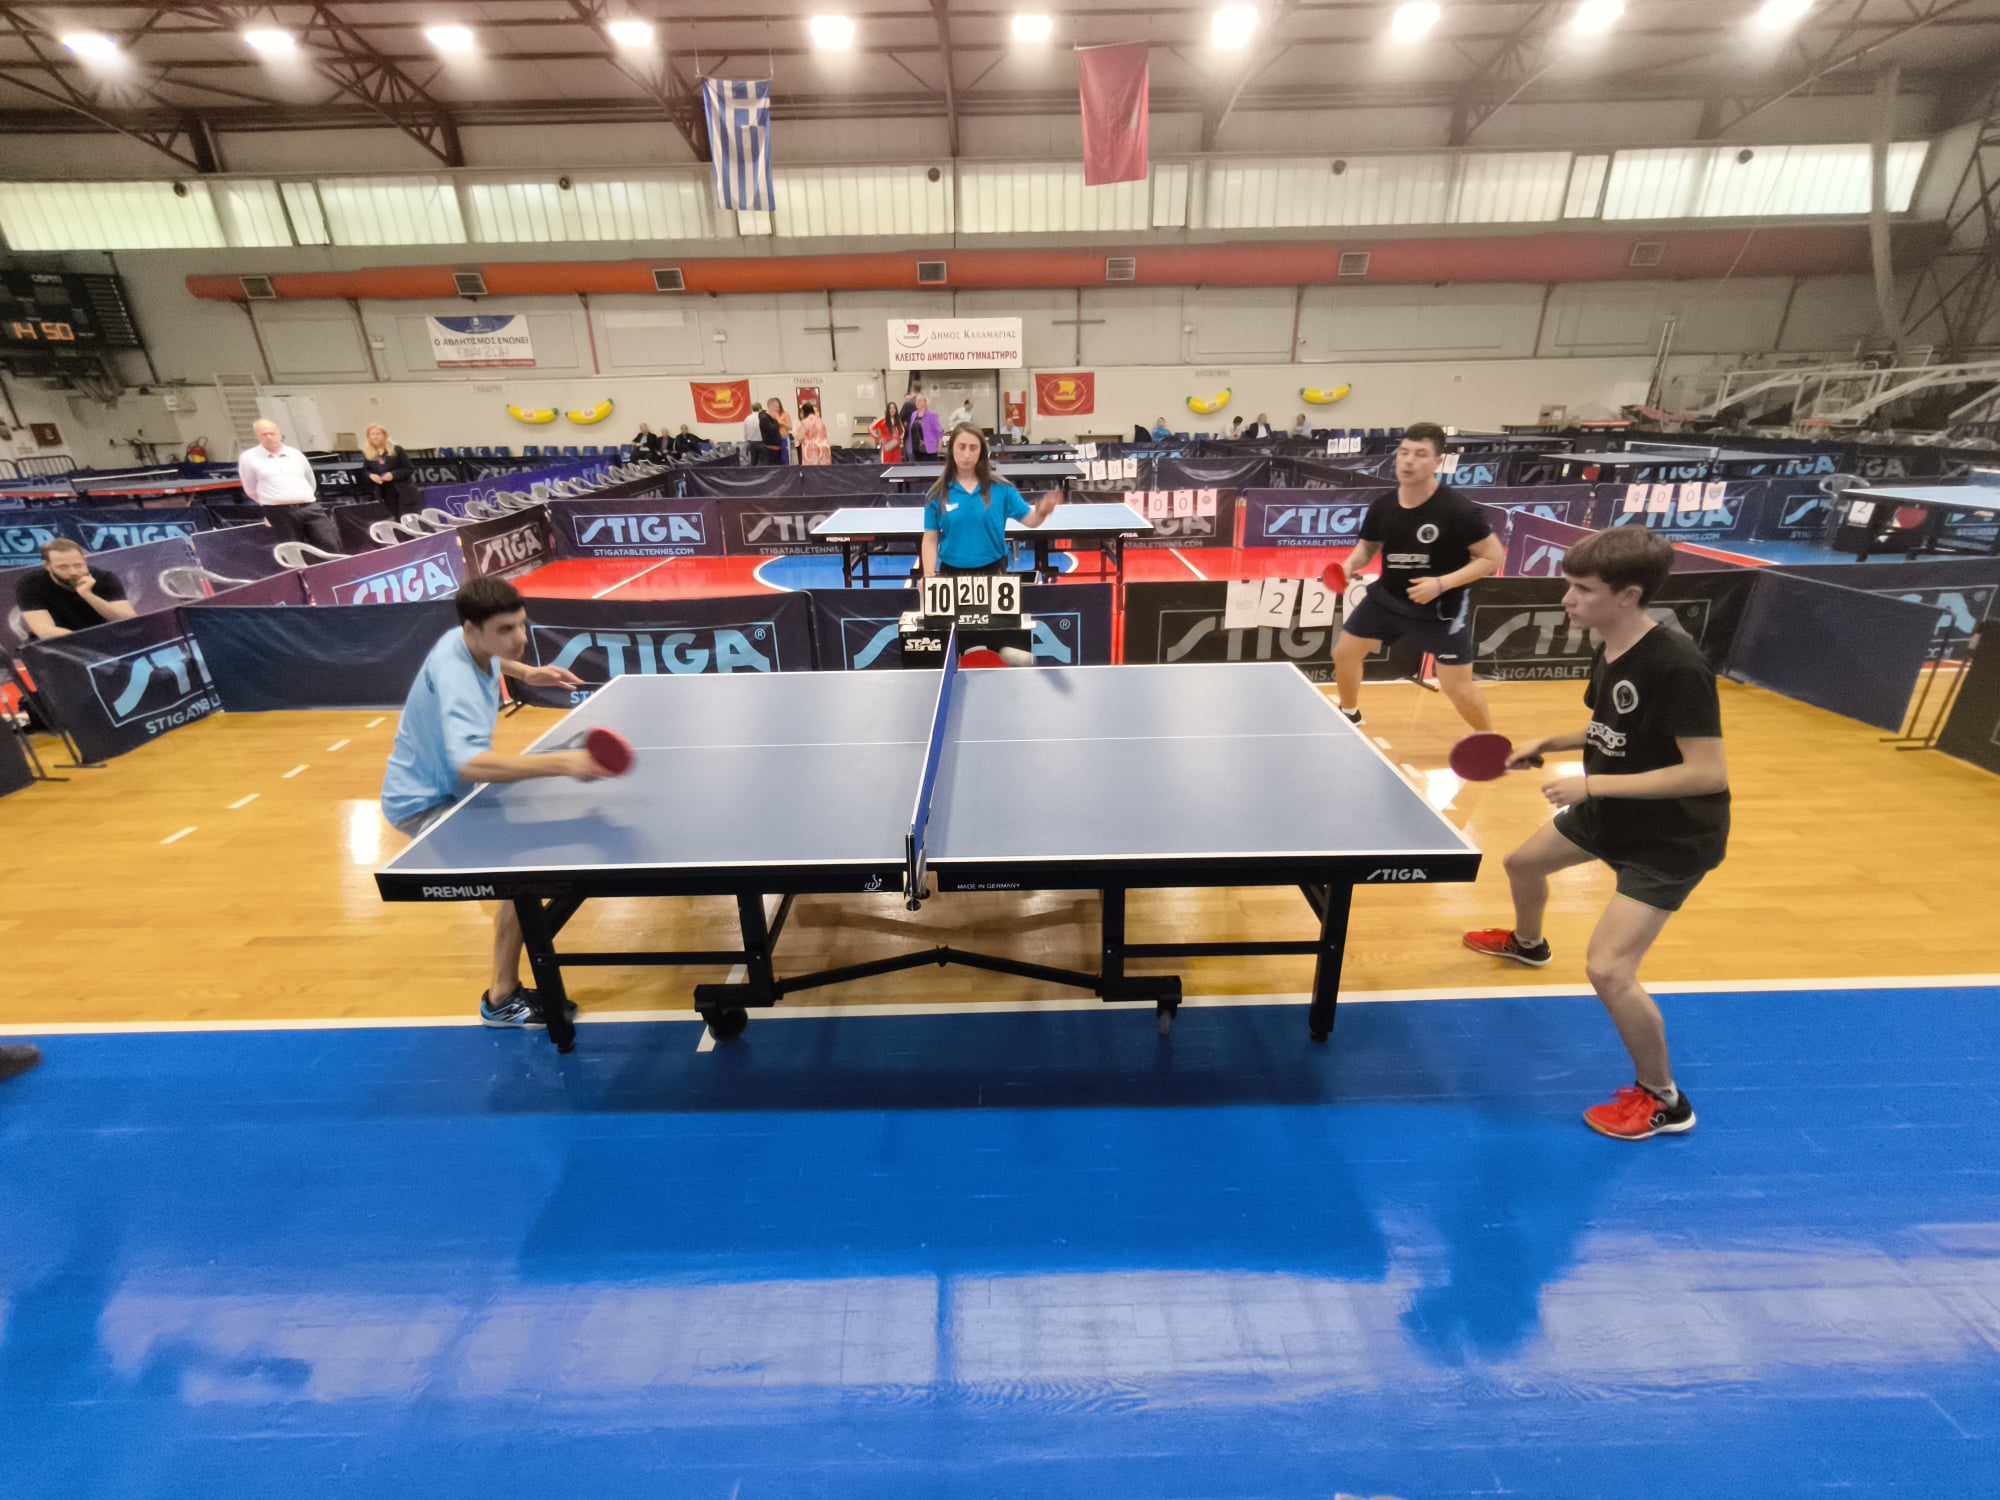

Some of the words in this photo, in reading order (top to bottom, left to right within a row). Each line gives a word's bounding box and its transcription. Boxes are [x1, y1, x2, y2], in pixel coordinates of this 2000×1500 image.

[895, 352, 926, 362] ΚΛΕΙΣΤΟ
[927, 352, 965, 362] ΔΗΜΟΤΙΚΟ
[967, 351, 1018, 361] ΓΥΜΝΑΣΤΗΡΙΟ
[581, 516, 700, 543] STIGA
[1268, 507, 1368, 534] STIG
[481, 526, 541, 574] STIGA
[593, 547, 696, 557] STIGATABLETENNIS.COM
[352, 562, 453, 605] STIGA
[959, 583, 971, 605] 2
[976, 583, 985, 605] 0
[927, 584, 951, 613] 10
[997, 582, 1014, 611] 8
[1269, 592, 1286, 614] 2
[1311, 592, 1325, 613] 2
[958, 614, 989, 625] STAG
[553, 629, 772, 678] STIGA
[904, 637, 942, 651] STAG
[1366, 868, 1428, 881] STIGA
[422, 885, 495, 898] PREMIUM
